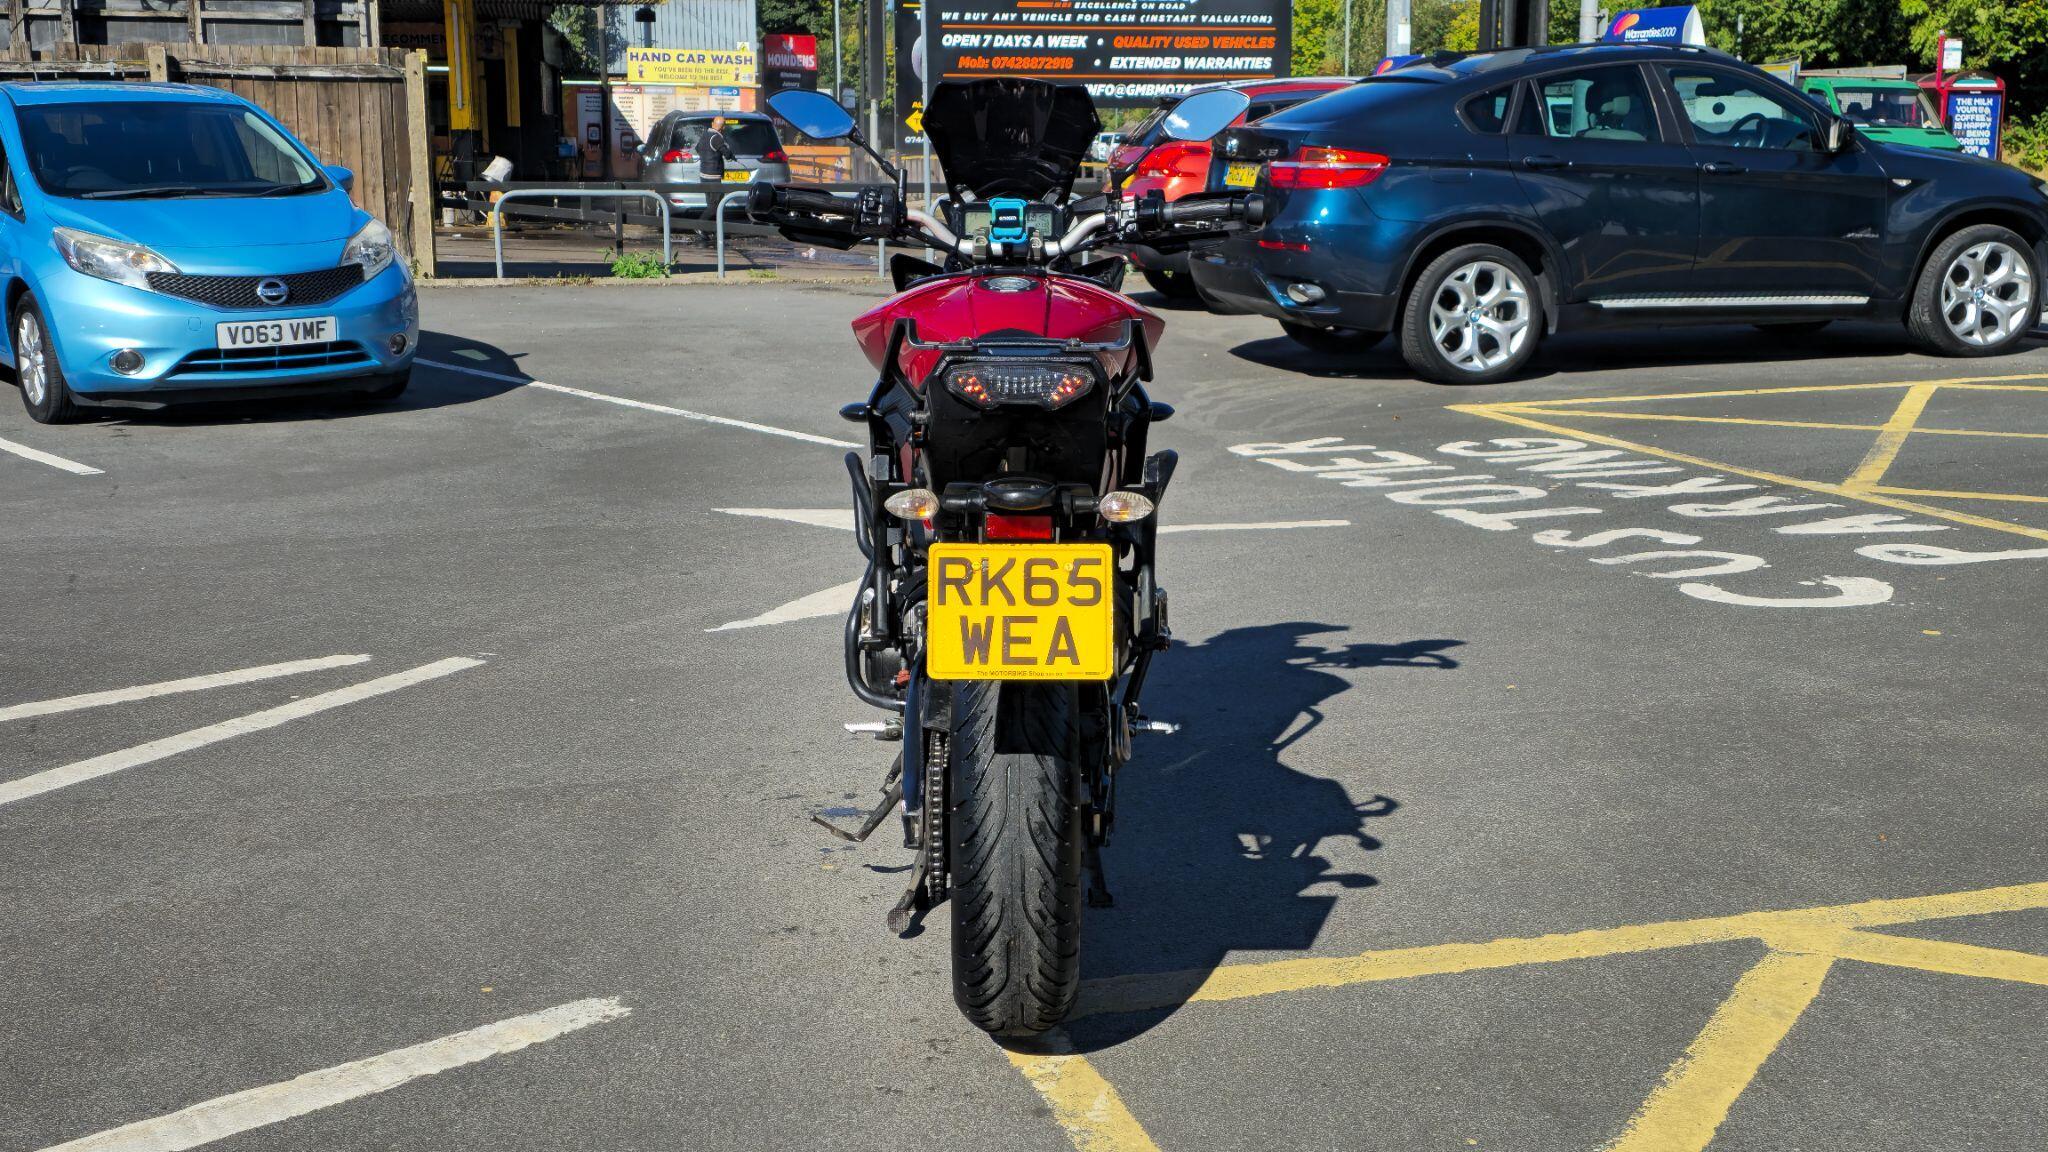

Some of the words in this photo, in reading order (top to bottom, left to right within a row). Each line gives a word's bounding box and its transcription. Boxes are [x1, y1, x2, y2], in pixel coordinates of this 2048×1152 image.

[941, 12, 960, 21] WE
[964, 12, 988, 21] BUY
[993, 13, 1017, 21] ANY
[1022, 13, 1072, 22] VEHICLE
[1076, 14, 1099, 22] FOR
[1104, 14, 1135, 22] CASH
[1140, 14, 1197, 23] (INSTANT
[1201, 15, 1273, 24] VALUATION)
[382, 34, 446, 44] ECOMMEN
[942, 34, 982, 47] OPEN
[982, 35, 993, 47] 7
[993, 35, 1032, 48] DAYS
[1033, 36, 1045, 48] A
[1047, 36, 1089, 48] WEEK
[1113, 36, 1173, 49] QUALITY
[1174, 36, 1209, 49] USED
[1212, 37, 1277, 49] VEHICLES
[629, 52, 671, 63] HAND
[676, 53, 706, 64] CAR
[711, 54, 753, 65] WASH
[767, 53, 815, 67] HOWDENS
[958, 56, 989, 69] Mob:
[1110, 56, 1181, 70] EXTENDED
[1183, 57, 1273, 70] WARRANTIES
[1956, 98, 1973, 106] THE
[1955, 106, 1978, 114] YOUR
[1963, 122, 1991, 130] HAPPY
[1966, 130, 1991, 138] BEING
[227, 324, 283, 345] VO63
[289, 320, 327, 342] VMF
[1436, 436, 2048, 566] PARKING
[1227, 436, 1896, 608] CUSTOMER
[937, 556, 1102, 607] RK65
[959, 615, 1081, 666] WEA
